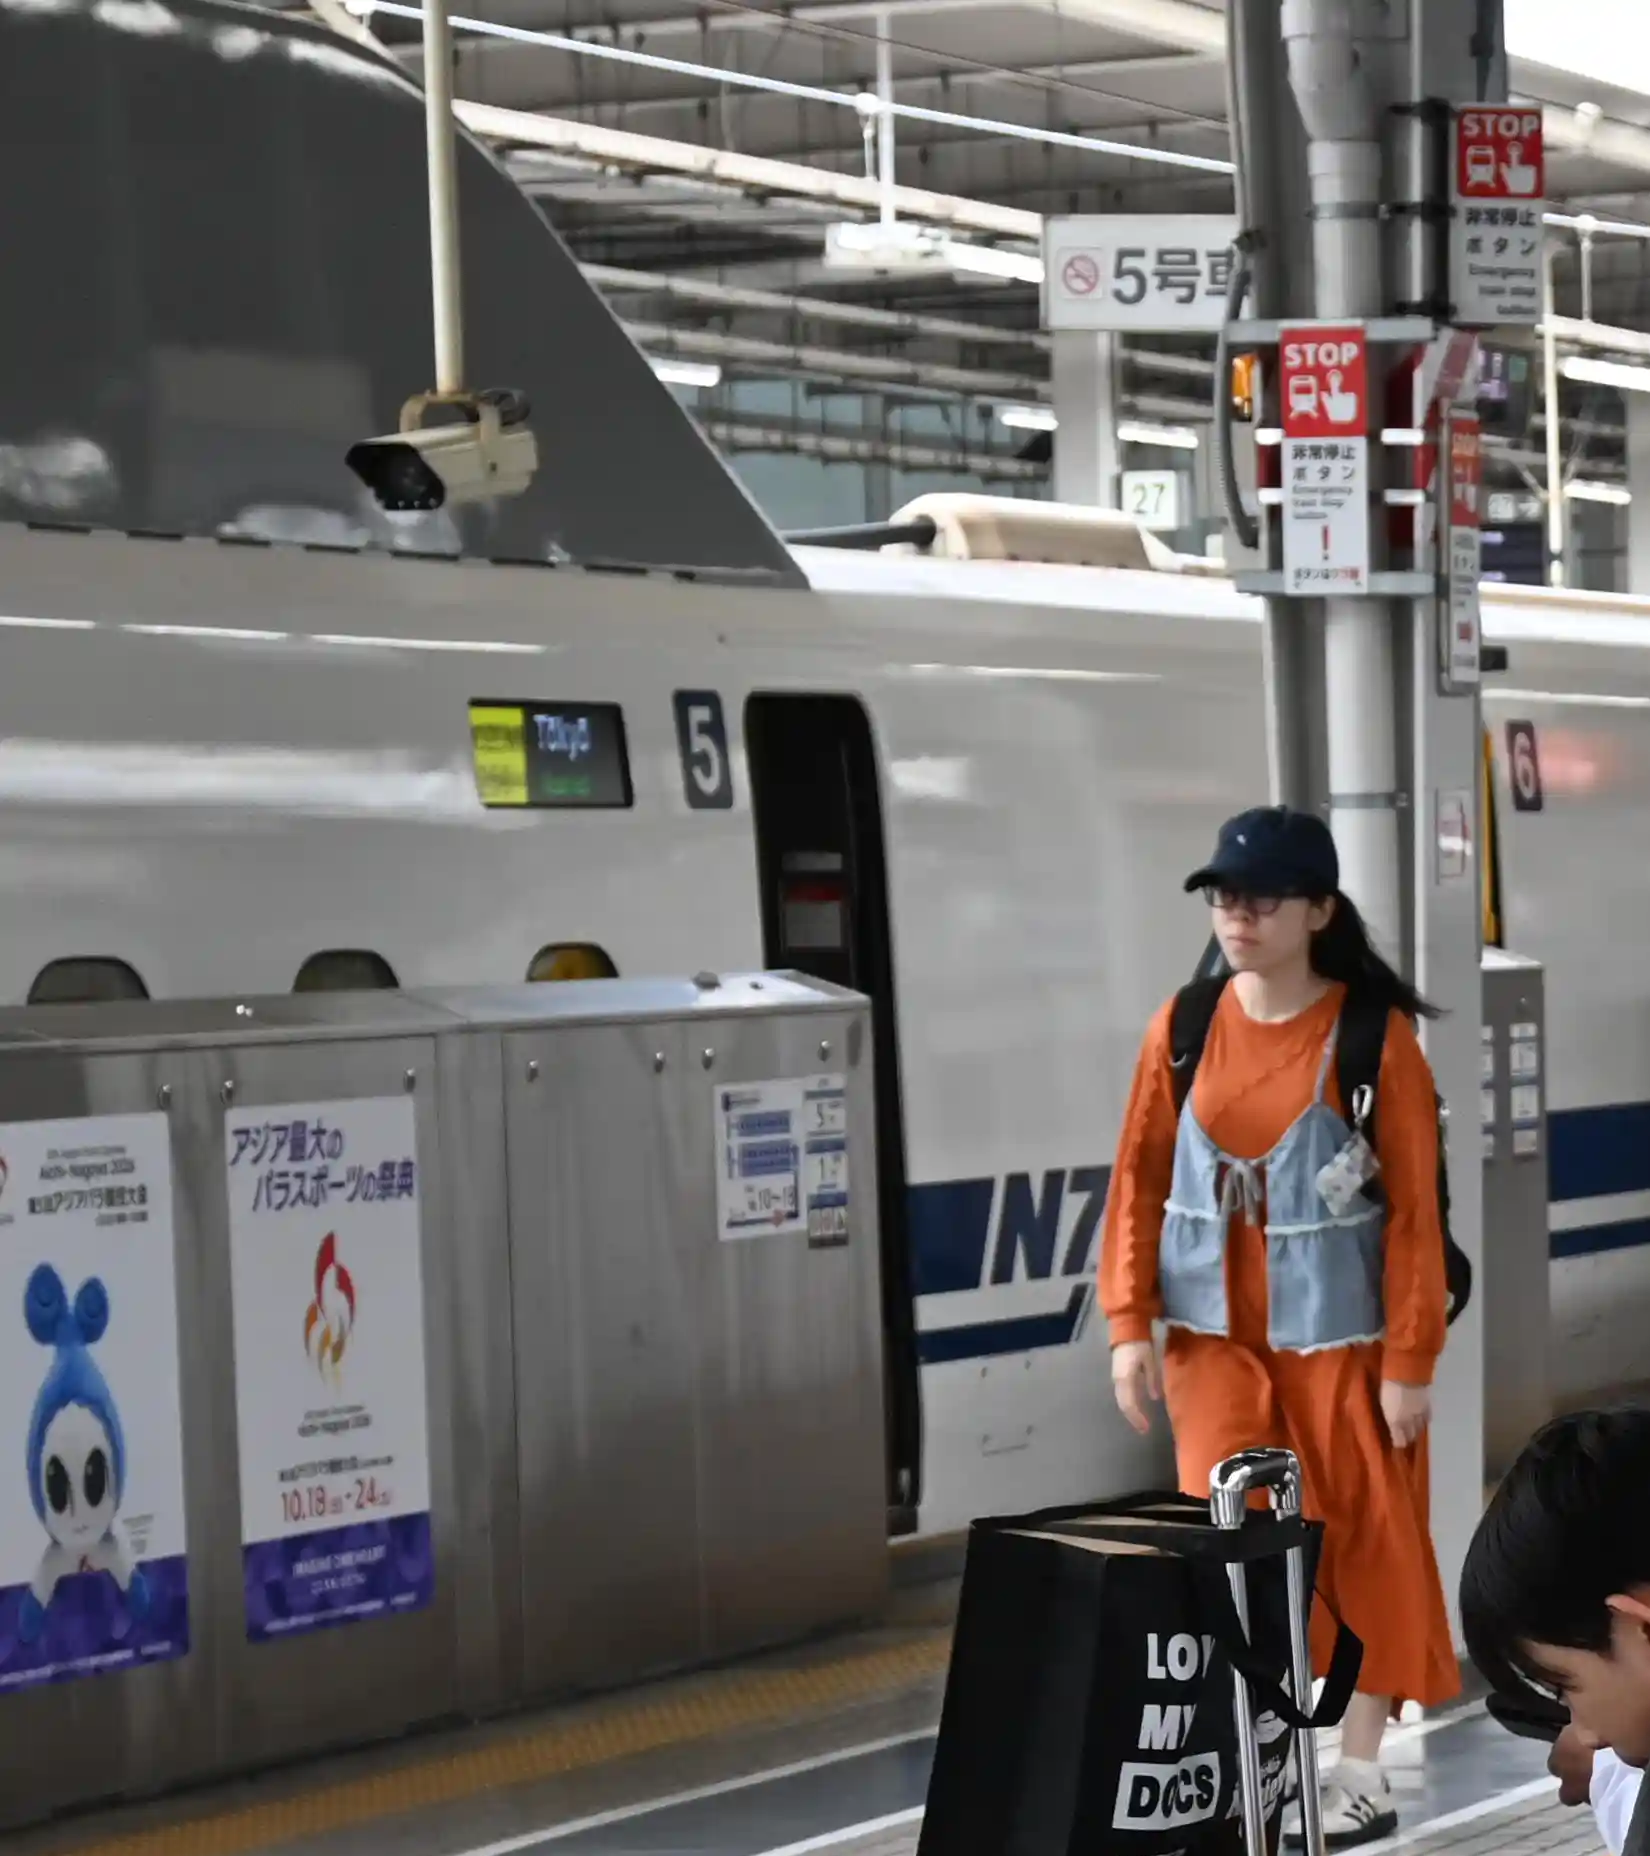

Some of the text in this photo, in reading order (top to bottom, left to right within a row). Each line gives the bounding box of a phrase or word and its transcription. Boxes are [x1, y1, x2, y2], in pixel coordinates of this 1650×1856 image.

[1463, 114, 1540, 137] STOP
[1466, 207, 1537, 226] 非常停止
[1284, 342, 1358, 368] STOP
[1292, 444, 1355, 460] 非常停止
[1132, 481, 1166, 515] 27
[687, 704, 721, 795] 5
[1512, 731, 1538, 801] 6
[1138, 1704, 1197, 1750] MY
